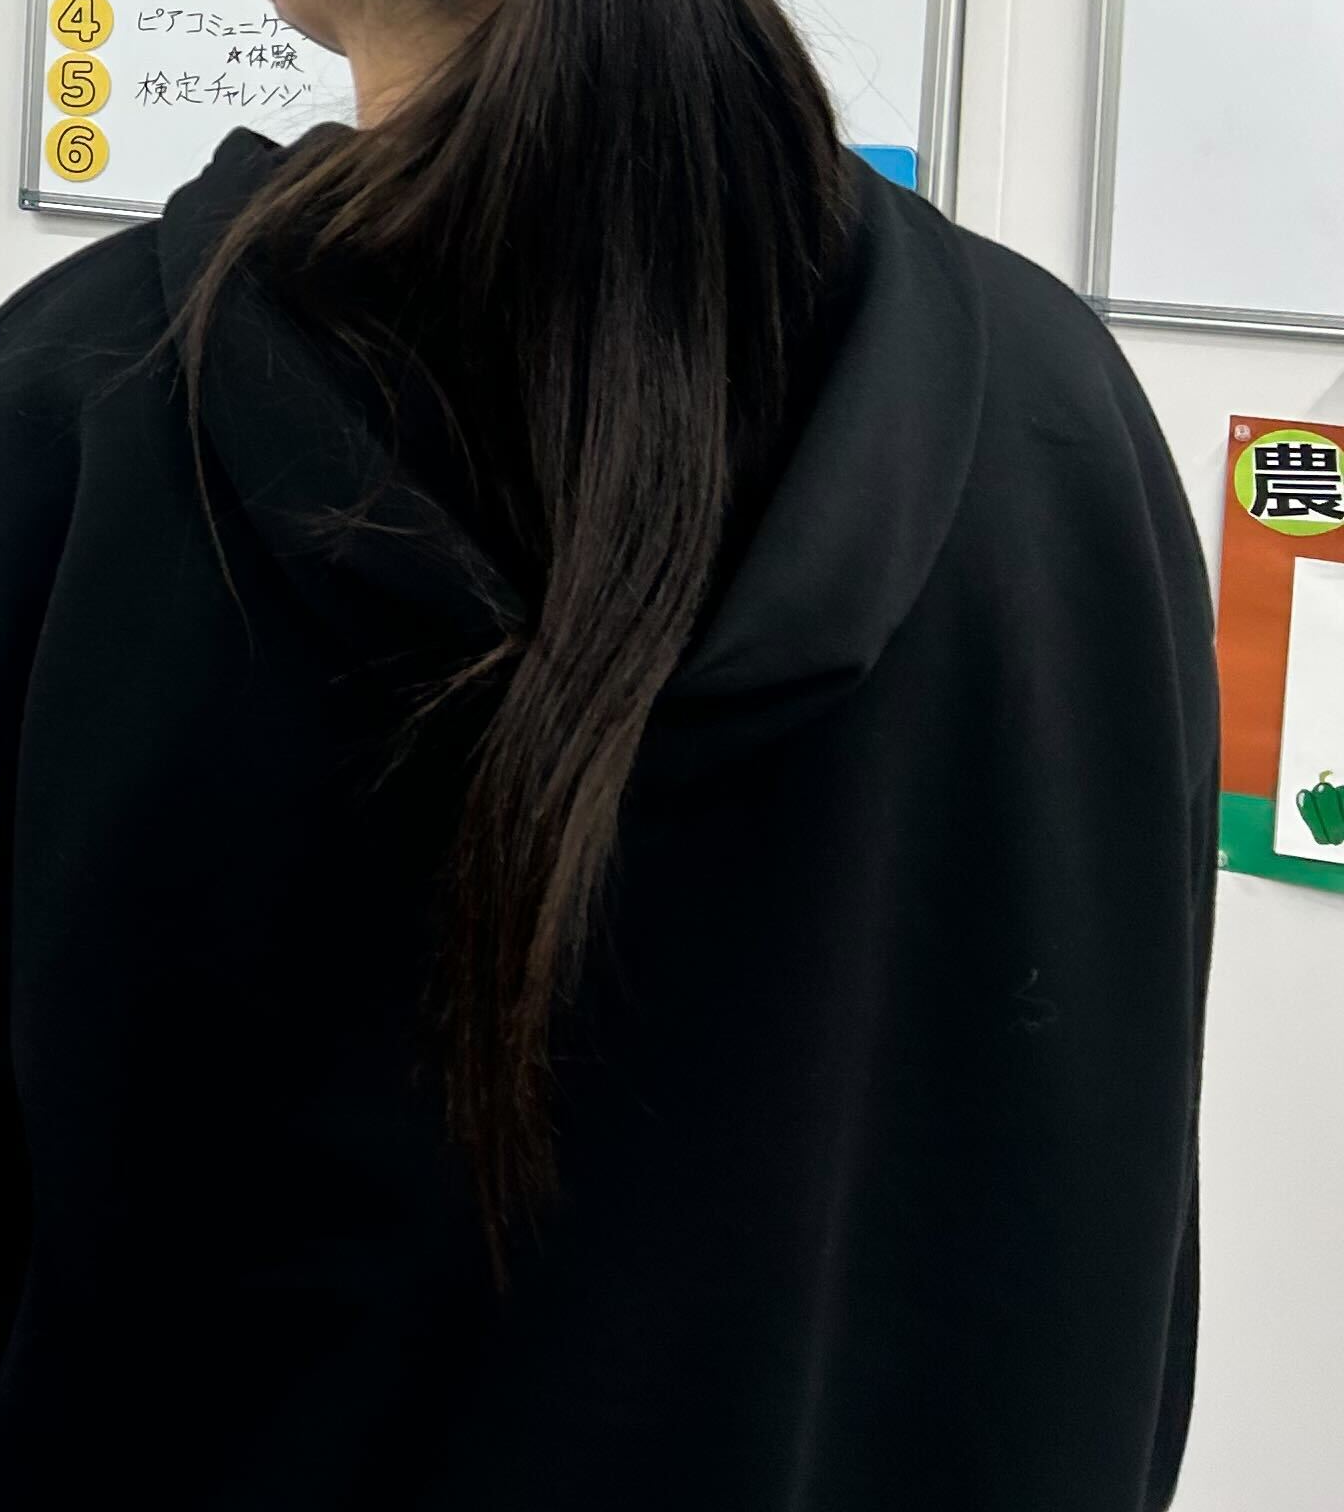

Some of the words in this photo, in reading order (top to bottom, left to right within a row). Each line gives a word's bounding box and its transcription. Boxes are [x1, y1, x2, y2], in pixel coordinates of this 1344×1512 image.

[137, 8, 312, 41] ピアコミュニケー
[60, 60, 96, 108] 5
[135, 70, 312, 108] 検定チャレンジ
[56, 125, 94, 174] 6
[1250, 443, 1344, 520] 農
